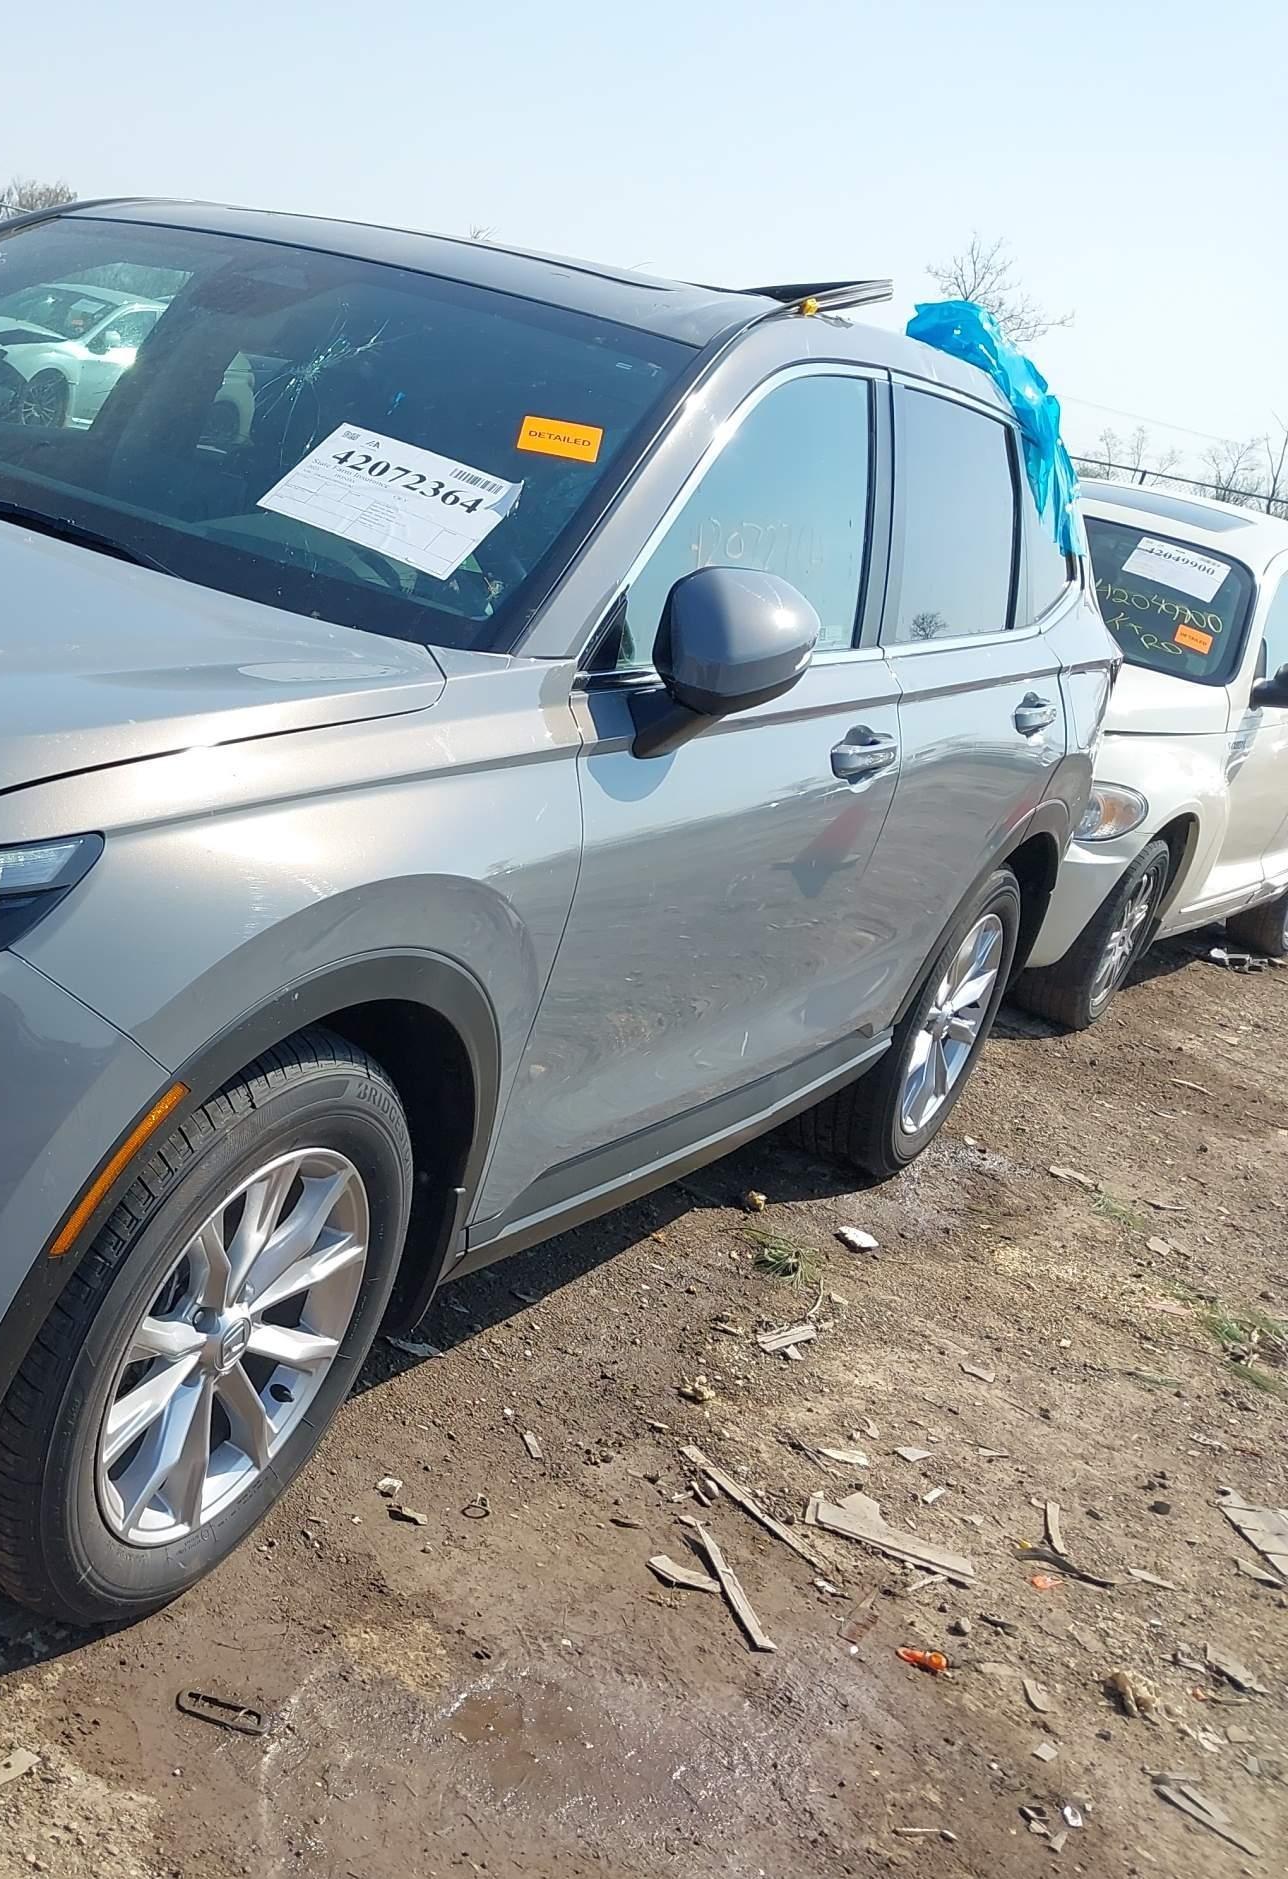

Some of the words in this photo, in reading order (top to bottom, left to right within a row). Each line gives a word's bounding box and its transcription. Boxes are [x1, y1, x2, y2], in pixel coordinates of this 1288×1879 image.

[528, 430, 591, 447] DETAILED
[312, 458, 331, 469] State
[332, 465, 353, 476] Farm
[353, 472, 391, 489] Insurance
[332, 450, 484, 514] 42072364
[1149, 547, 1215, 576] 42049900
[1095, 578, 1223, 633] 42049900
